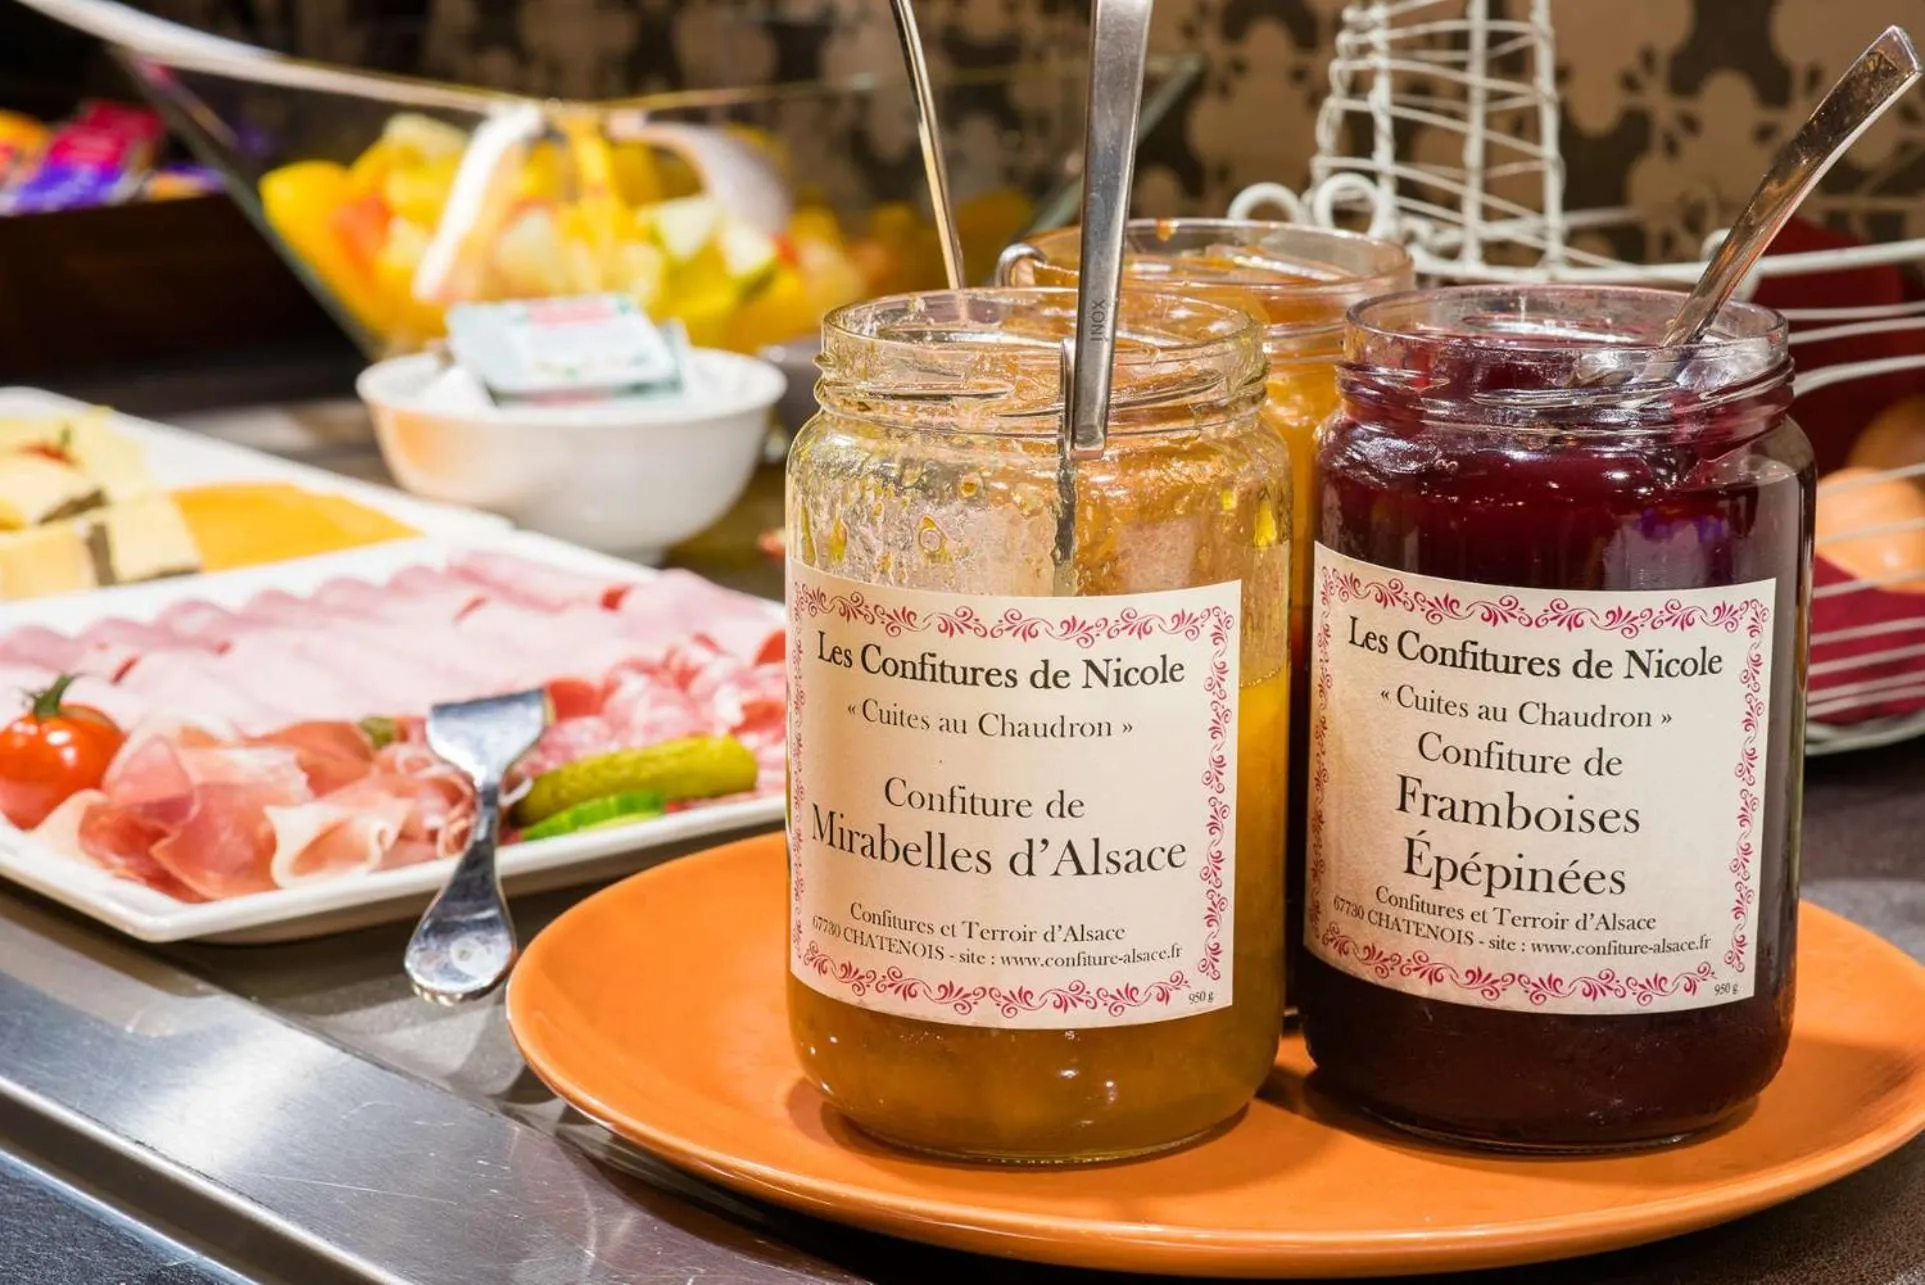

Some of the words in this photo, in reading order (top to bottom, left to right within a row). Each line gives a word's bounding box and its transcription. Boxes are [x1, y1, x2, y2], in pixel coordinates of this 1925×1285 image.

[1090, 299, 1106, 341] INOX
[818, 631, 852, 668] Les
[861, 644, 1018, 689] Confitures
[1030, 659, 1071, 689] de
[1082, 655, 1185, 689] Nicole
[1349, 616, 1388, 654] Les
[1397, 630, 1560, 678] Confitures
[1572, 649, 1613, 679] de
[1624, 647, 1723, 679] Nicole
[862, 698, 930, 731] Cuites
[939, 715, 967, 734] au
[978, 712, 1113, 738] Chaudron
[1397, 685, 1468, 719] Cuites
[1478, 703, 1507, 722] au
[1518, 701, 1652, 728] Chaudron
[1418, 731, 1571, 775] Confiture
[1584, 747, 1623, 777] de
[884, 777, 1032, 819] Confiture
[1045, 791, 1085, 819] de
[1396, 774, 1641, 834] Framboises
[811, 803, 992, 875] Mirabelles
[1009, 837, 1187, 877] d’Alsace
[1403, 830, 1627, 899] Épépinées
[850, 902, 934, 936] Confitures
[940, 922, 956, 938] et
[962, 920, 1037, 942] Terroir
[1043, 924, 1125, 943] d’Alsace
[1333, 896, 1365, 921] 67730
[1367, 910, 1474, 947] CHATENOIS
[1488, 935, 1516, 952] site
[1531, 934, 1712, 957] www.confiture-alsace.fr
[1376, 885, 1464, 921] Confitures
[1470, 908, 1487, 923] et
[1492, 907, 1569, 930] Terroir
[1575, 913, 1656, 931] d’Alsace
[812, 915, 841, 938] 67730
[843, 926, 944, 961] CHATENOIS
[959, 949, 987, 965] site
[1001, 943, 1183, 968] www.confiture-alsace.fr
[1188, 991, 1207, 1005] 950
[1714, 982, 1730, 996] 950
